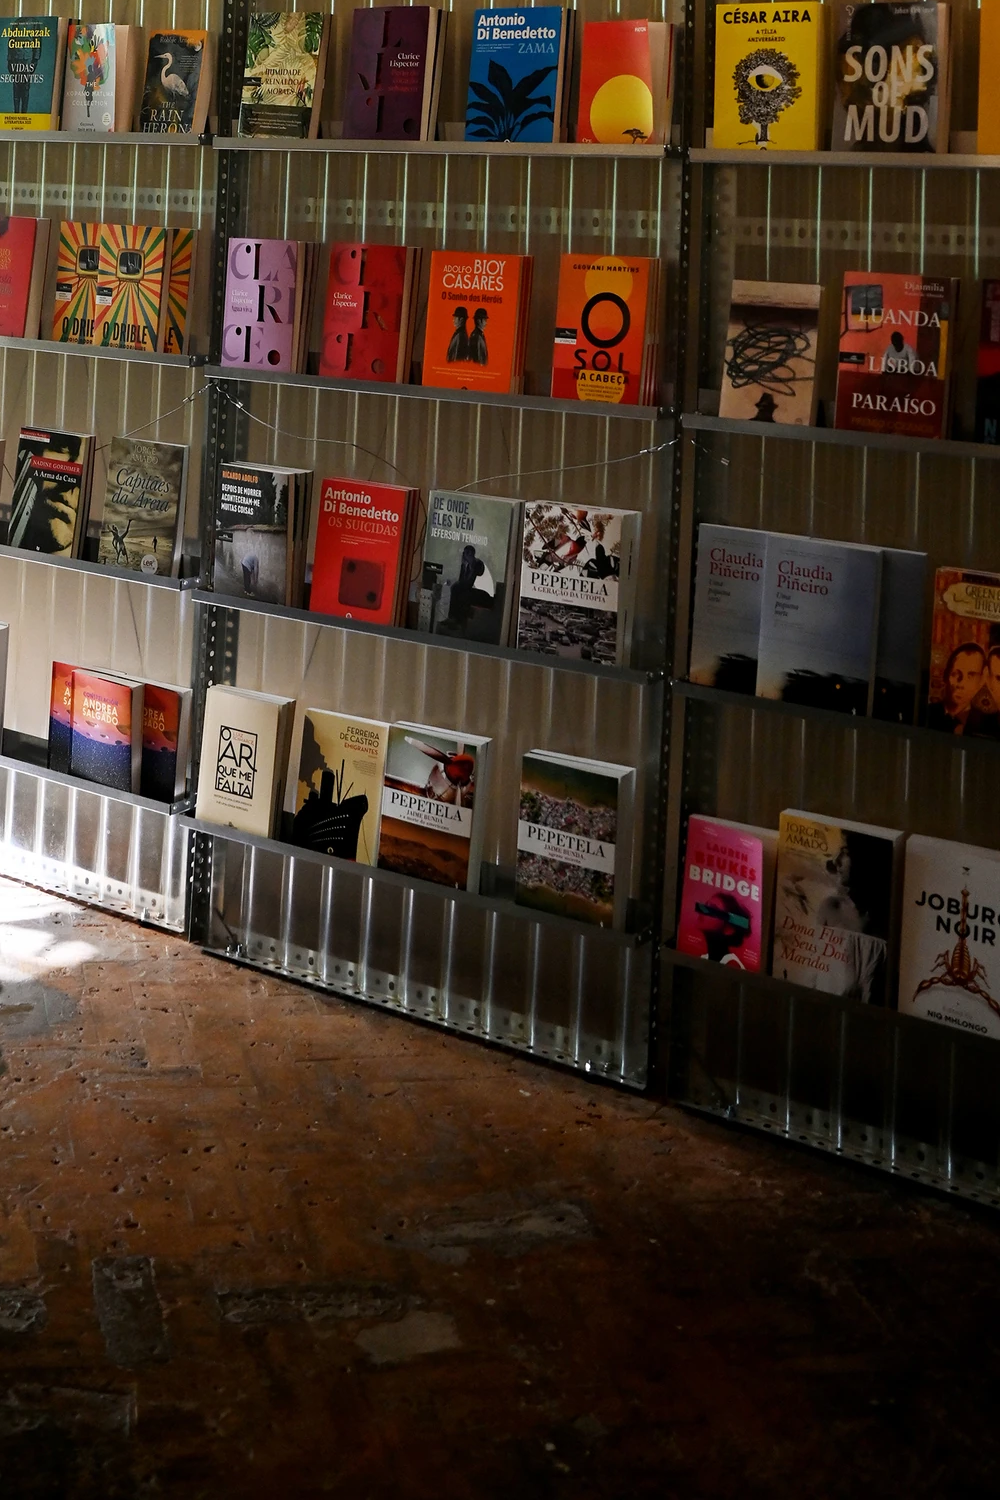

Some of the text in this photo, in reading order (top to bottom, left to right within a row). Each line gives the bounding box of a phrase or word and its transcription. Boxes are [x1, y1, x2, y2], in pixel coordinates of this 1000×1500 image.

[478, 13, 526, 28] Antonio
[723, 8, 812, 24] CÉSAR AIRA
[1, 27, 51, 38] Abdulrazak
[476, 26, 556, 41] Di Benedetto
[8, 38, 41, 49] Gurnah
[517, 43, 555, 54] ZAMA
[389, 60, 420, 69] Lispector
[397, 52, 421, 61] Clarice
[843, 44, 935, 84] SONS
[11, 63, 35, 73] VIDAS
[0, 73, 44, 84] SEGUINTES
[150, 109, 185, 123] RAIN
[843, 104, 930, 143] MUD
[443, 259, 506, 276] ADOLFO BIOY
[573, 263, 640, 273] GEOVANI MARTINS
[442, 273, 504, 291] CASARES
[332, 299, 358, 308] Lispector
[333, 292, 353, 300] Clarice
[441, 292, 503, 304] O Sonho dos Heróis
[858, 306, 942, 328] LUANDA
[102, 321, 149, 345] O DRIBLE
[573, 349, 630, 375] SOL
[868, 355, 939, 378] LISBOA
[573, 372, 629, 386] NA CABEÇA
[851, 393, 937, 417] PARAÍSO
[133, 444, 158, 456] JORGE
[32, 459, 80, 473] NADINE GORDIMER
[39, 471, 55, 479] Arma
[63, 475, 77, 484] Casa
[115, 467, 172, 497] Capitães
[222, 470, 259, 484] RICARDO ADOLFO
[111, 487, 170, 512] da Areia
[221, 483, 262, 498] DEPOIS DE MORRER
[324, 486, 372, 504] Antonio
[221, 493, 260, 507] ACONTECERAM-ME
[433, 497, 470, 514] DE ONDE
[221, 503, 254, 516] MUITAS COISAS
[323, 500, 400, 523] Di Benedetto
[328, 516, 399, 537] OS SUICIDAS
[432, 511, 475, 531] ELES VÊM
[430, 529, 488, 546] JEFERSON TENÓRIO
[709, 547, 763, 569] Claudia
[709, 561, 760, 583] Piñeiro
[777, 560, 833, 582] Claudia
[531, 571, 609, 596] PEPETELA
[776, 573, 829, 597] Piñeiro
[538, 586, 568, 598] GERAÇÃO
[569, 591, 580, 599] DA
[581, 592, 606, 603] UTOPIA
[82, 698, 119, 717] ANDREA
[82, 707, 119, 726] SALGADO
[339, 734, 379, 749] DE CASTRO
[346, 726, 380, 740] FERREIRA
[218, 740, 258, 773] AR
[344, 743, 379, 756] EMIGRANTES
[217, 764, 252, 783] QUE ME
[217, 776, 252, 797] FALTA
[390, 791, 463, 823] PEPETELA
[406, 809, 444, 825] JAIME BUNDA
[785, 821, 819, 838] JORGE
[527, 825, 606, 859] PEPETELA
[785, 834, 829, 853] AMADO
[706, 842, 749, 863] LAUREN
[695, 850, 757, 881] BEUKES
[688, 864, 760, 902] BRIDGE
[782, 915, 844, 946] Dona Flor
[935, 914, 997, 947] NOIR
[793, 933, 850, 964] Seus Dois
[779, 946, 831, 974] Maridos
[926, 1009, 989, 1034] NIQ MHLONGO
